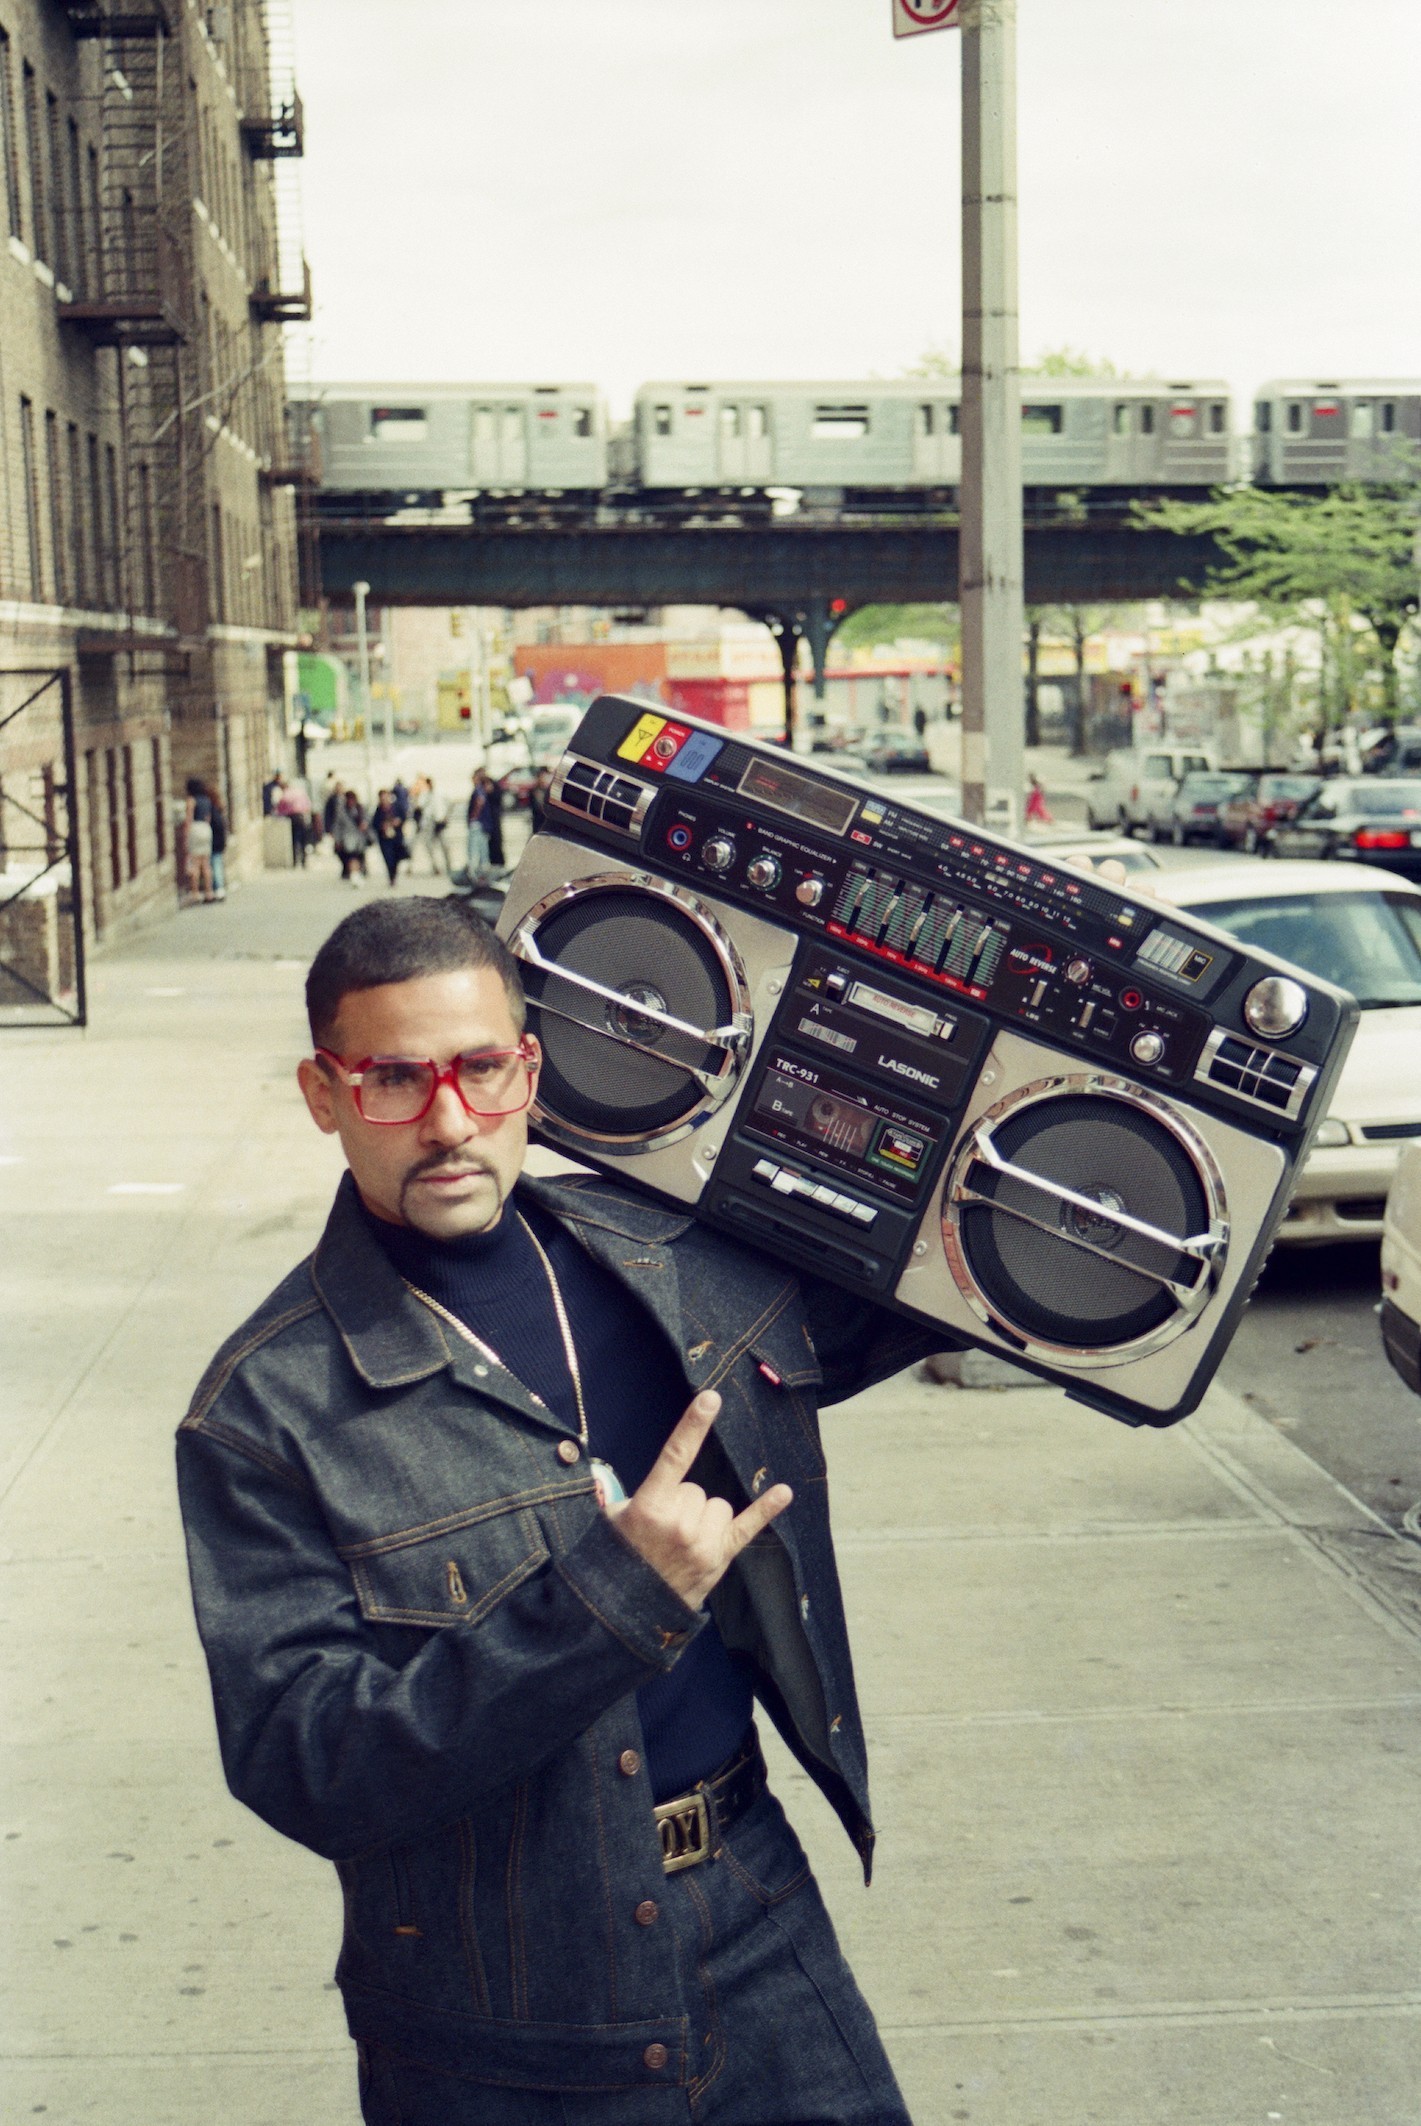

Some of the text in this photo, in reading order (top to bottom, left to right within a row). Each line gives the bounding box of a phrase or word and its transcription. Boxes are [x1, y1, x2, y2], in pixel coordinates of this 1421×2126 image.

[717, 827, 735, 837] VOLUME
[757, 828, 773, 838] BAND
[774, 835, 799, 848] GRAPHIC
[800, 845, 832, 861] EQUALIZER
[762, 846, 781, 857] BALANCE
[1019, 866, 1030, 874] 100
[1042, 874, 1053, 883] 104
[1067, 885, 1078, 893] 108
[1033, 881, 1045, 889] 120
[1053, 889, 1064, 897] 140
[1070, 896, 1081, 904] 160
[802, 912, 824, 924] FUNCTION
[1009, 948, 1057, 974] AUTO REVERSE
[1194, 954, 1206, 964] MIC
[872, 994, 915, 1017] AUTO REVERSE
[774, 1058, 819, 1083] TRC-931
[877, 1054, 940, 1088] LASONIC
[781, 1108, 793, 1116] TAPE
[874, 1104, 930, 1132] AUTO STOP SYSTEM
